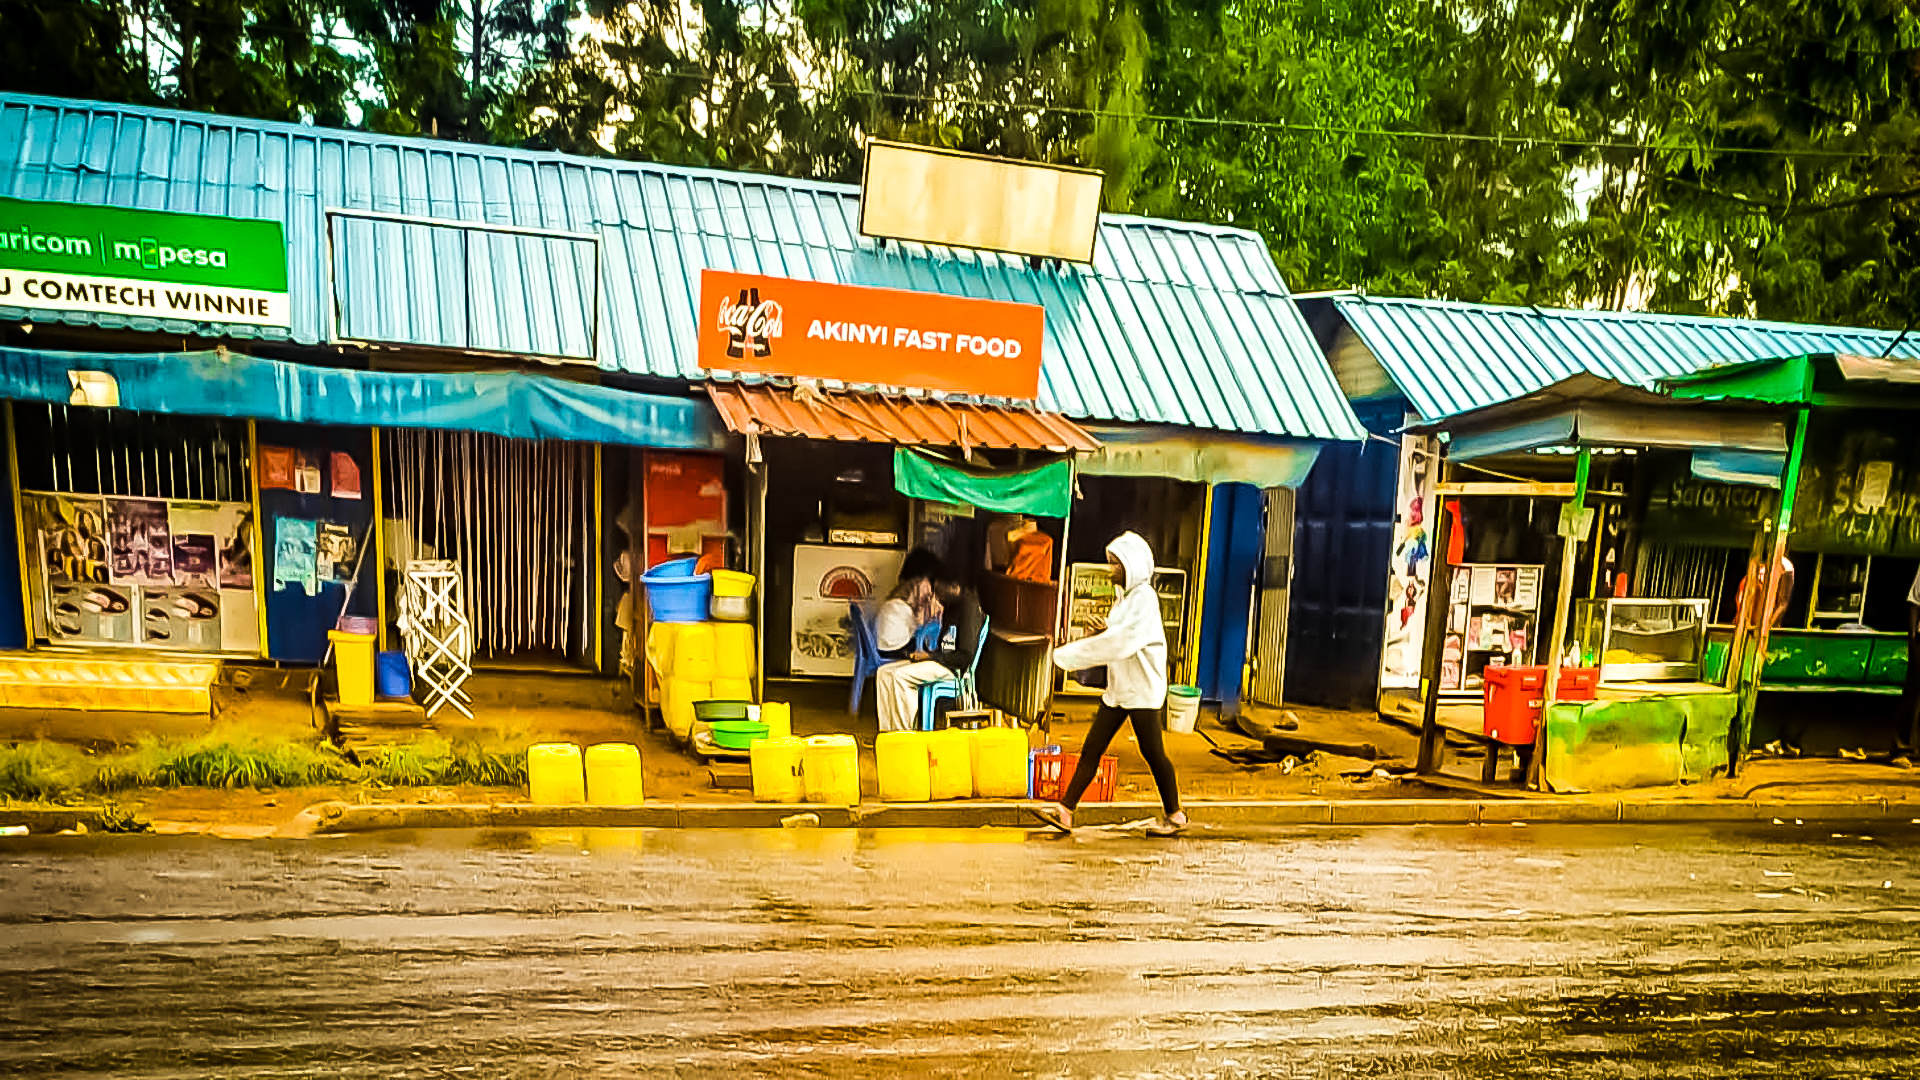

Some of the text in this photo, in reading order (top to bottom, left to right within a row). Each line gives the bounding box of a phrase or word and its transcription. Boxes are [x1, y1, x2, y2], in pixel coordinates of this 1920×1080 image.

[24, 278, 155, 307] COMTECH
[165, 290, 269, 316] WINNIE
[717, 296, 783, 338] Coca-Cola
[807, 319, 1021, 359] AKINYI FAST FOOD
